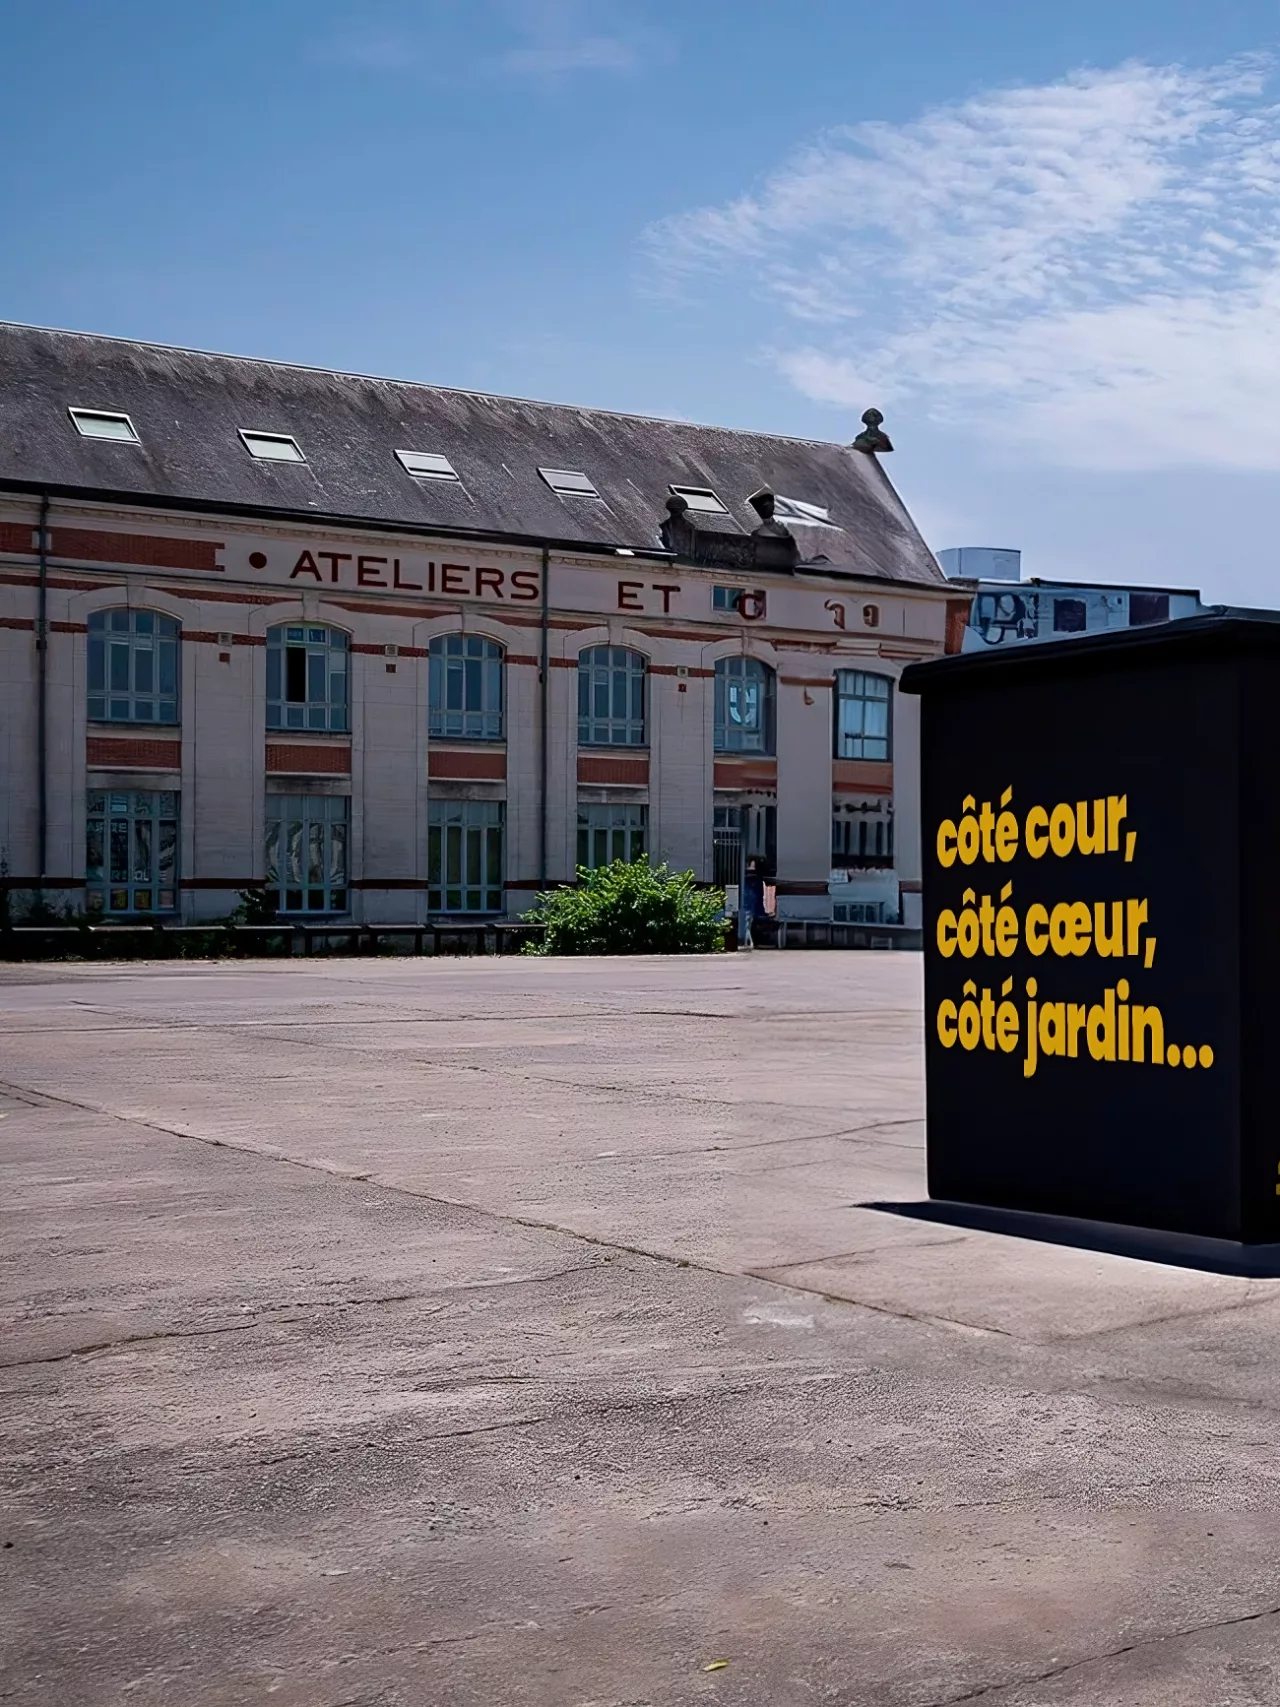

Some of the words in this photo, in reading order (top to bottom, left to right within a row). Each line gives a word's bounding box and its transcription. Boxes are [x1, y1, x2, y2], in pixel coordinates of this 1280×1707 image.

[289, 549, 541, 600] ATELIERS
[617, 580, 681, 613] ET
[936, 785, 1019, 869] côté
[1024, 794, 1138, 863] cour,
[935, 879, 1019, 959] côté
[1024, 897, 1157, 969] cœur,
[936, 975, 1020, 1054] côté
[1023, 976, 1215, 1078] jardin...
